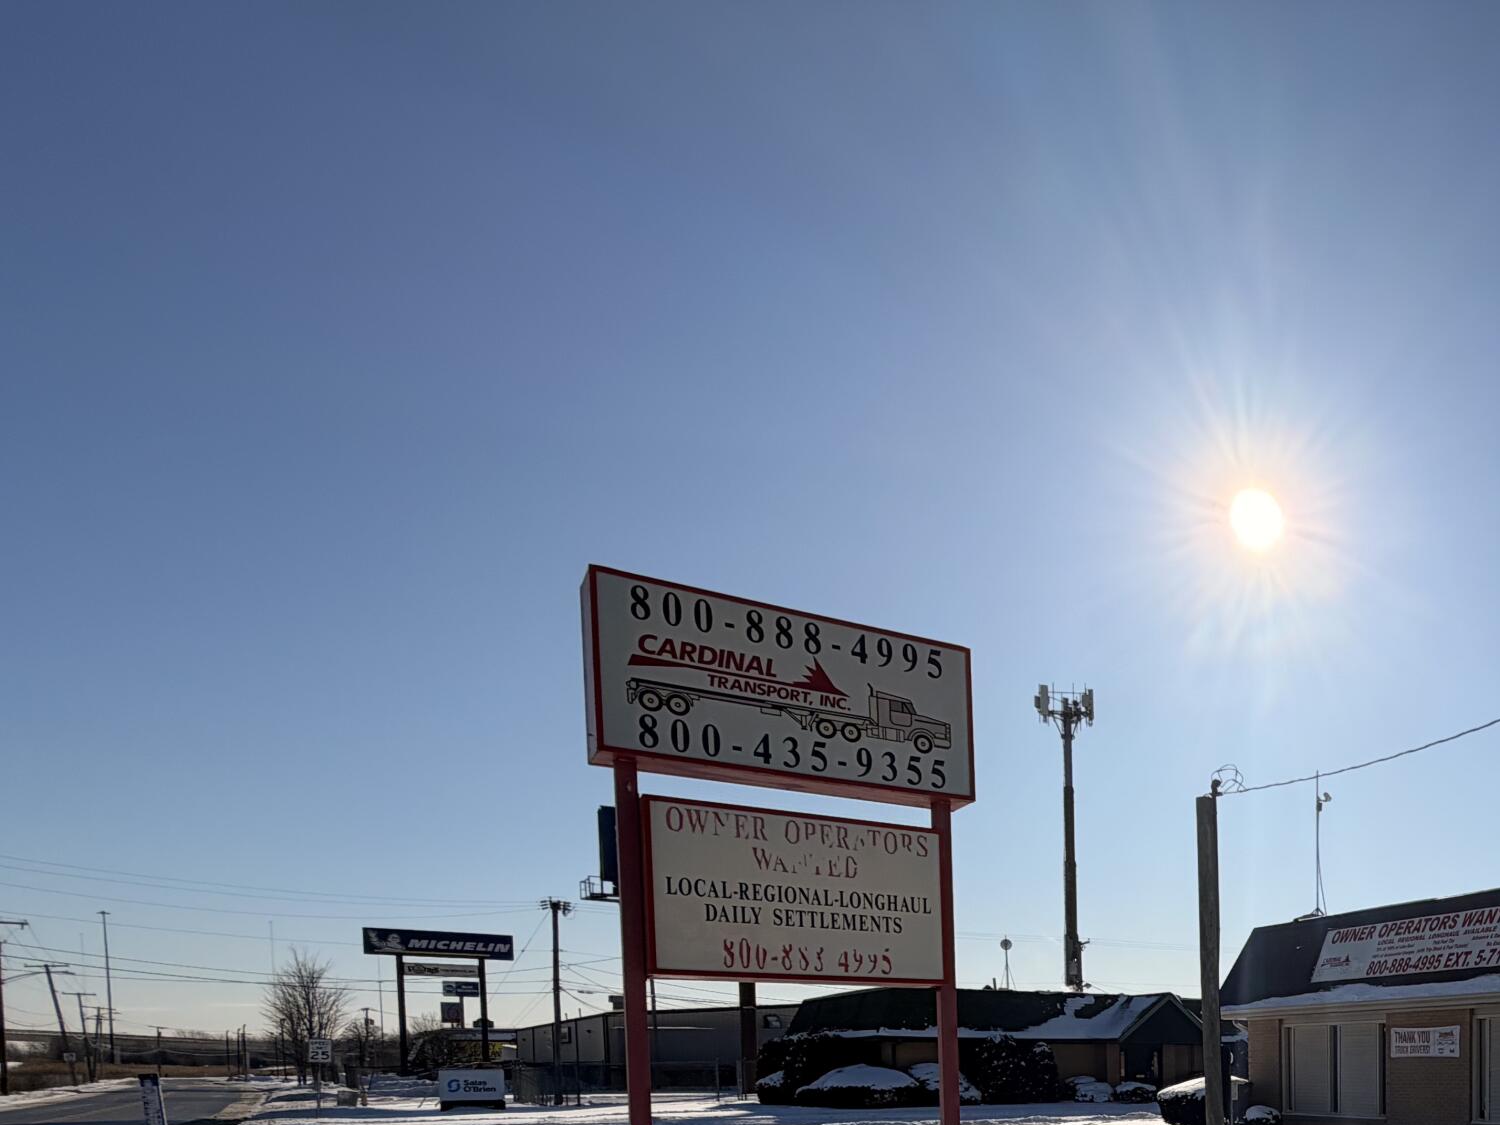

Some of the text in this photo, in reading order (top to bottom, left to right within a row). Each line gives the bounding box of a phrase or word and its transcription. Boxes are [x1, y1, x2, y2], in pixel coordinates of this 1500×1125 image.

[630, 584, 943, 680] 800-888-4995
[638, 633, 778, 678] CARDINAL
[707, 673, 851, 712] TRANSPORT, INC.
[638, 712, 947, 790] 800-435-9355
[665, 805, 769, 841] OWNER
[751, 846, 858, 880] WAED
[665, 875, 932, 915] LOCAL-REGIONAL-LONGHAUL
[704, 902, 904, 935] DAILY SETTLEMENTS
[1331, 926, 1377, 945] OWNER
[1378, 913, 1460, 938] OPERATORS
[1463, 925, 1498, 936] AVAILABLE
[407, 938, 511, 953] MICHELIN
[1366, 953, 1444, 977] 800-888-4995
[1442, 951, 1472, 970] EXT.
[1395, 1031, 1416, 1045] THANK
[1416, 1031, 1431, 1044] YOU
[310, 1051, 329, 1060] 25
[463, 1079, 488, 1087] Salas
[463, 1085, 497, 1094] O'Brien
